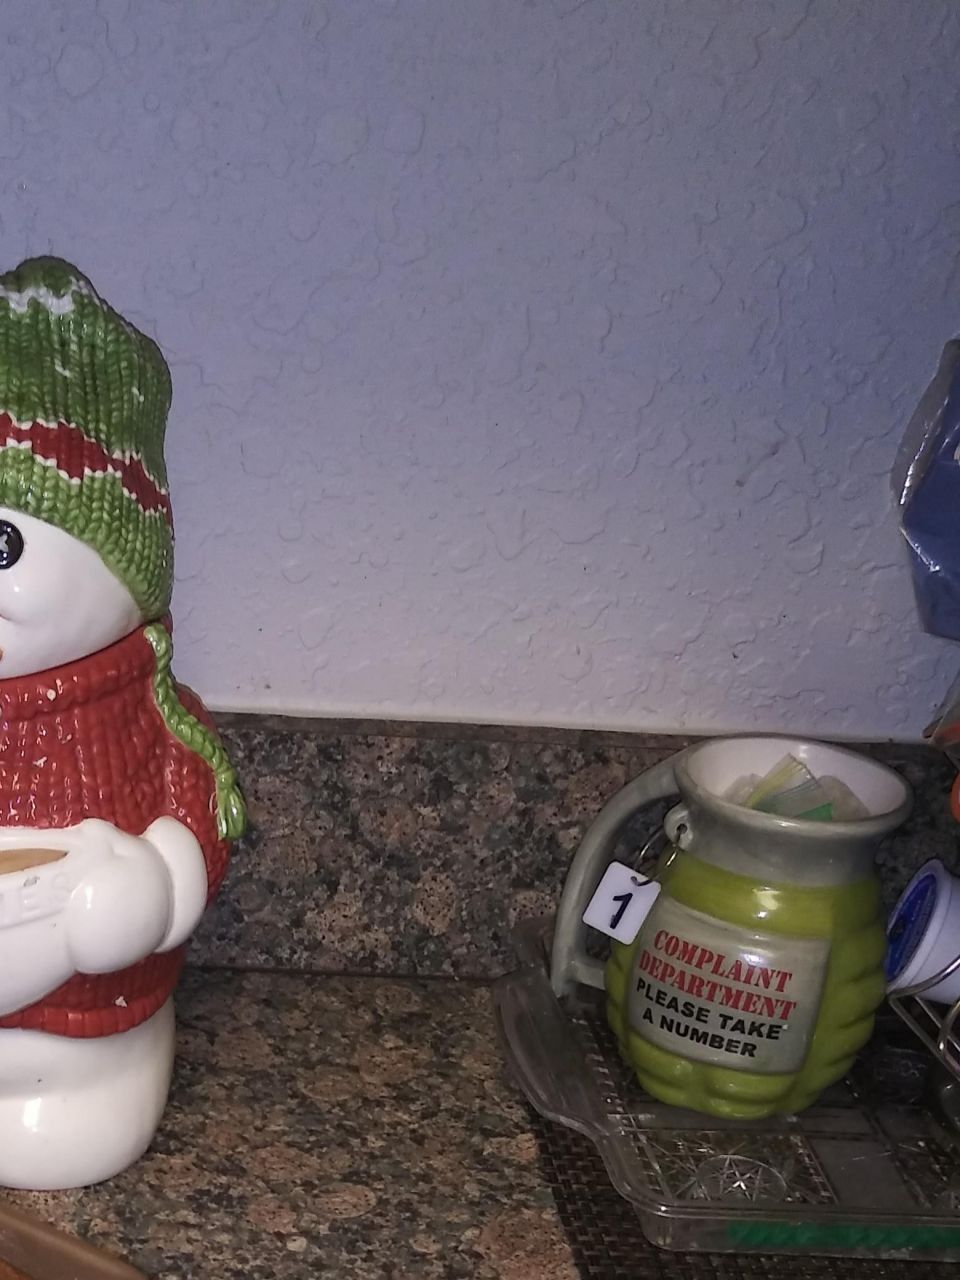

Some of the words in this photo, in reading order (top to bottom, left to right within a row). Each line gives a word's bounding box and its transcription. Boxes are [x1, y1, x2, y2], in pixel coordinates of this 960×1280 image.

[610, 892, 633, 929] 1
[639, 950, 797, 1020] DEPARTMENT
[654, 929, 792, 992] COMPLAINT
[636, 977, 711, 1024] PLEASE
[718, 1013, 782, 1040] TAKE
[642, 1007, 654, 1024] A
[659, 1015, 758, 1058] NUMBER
